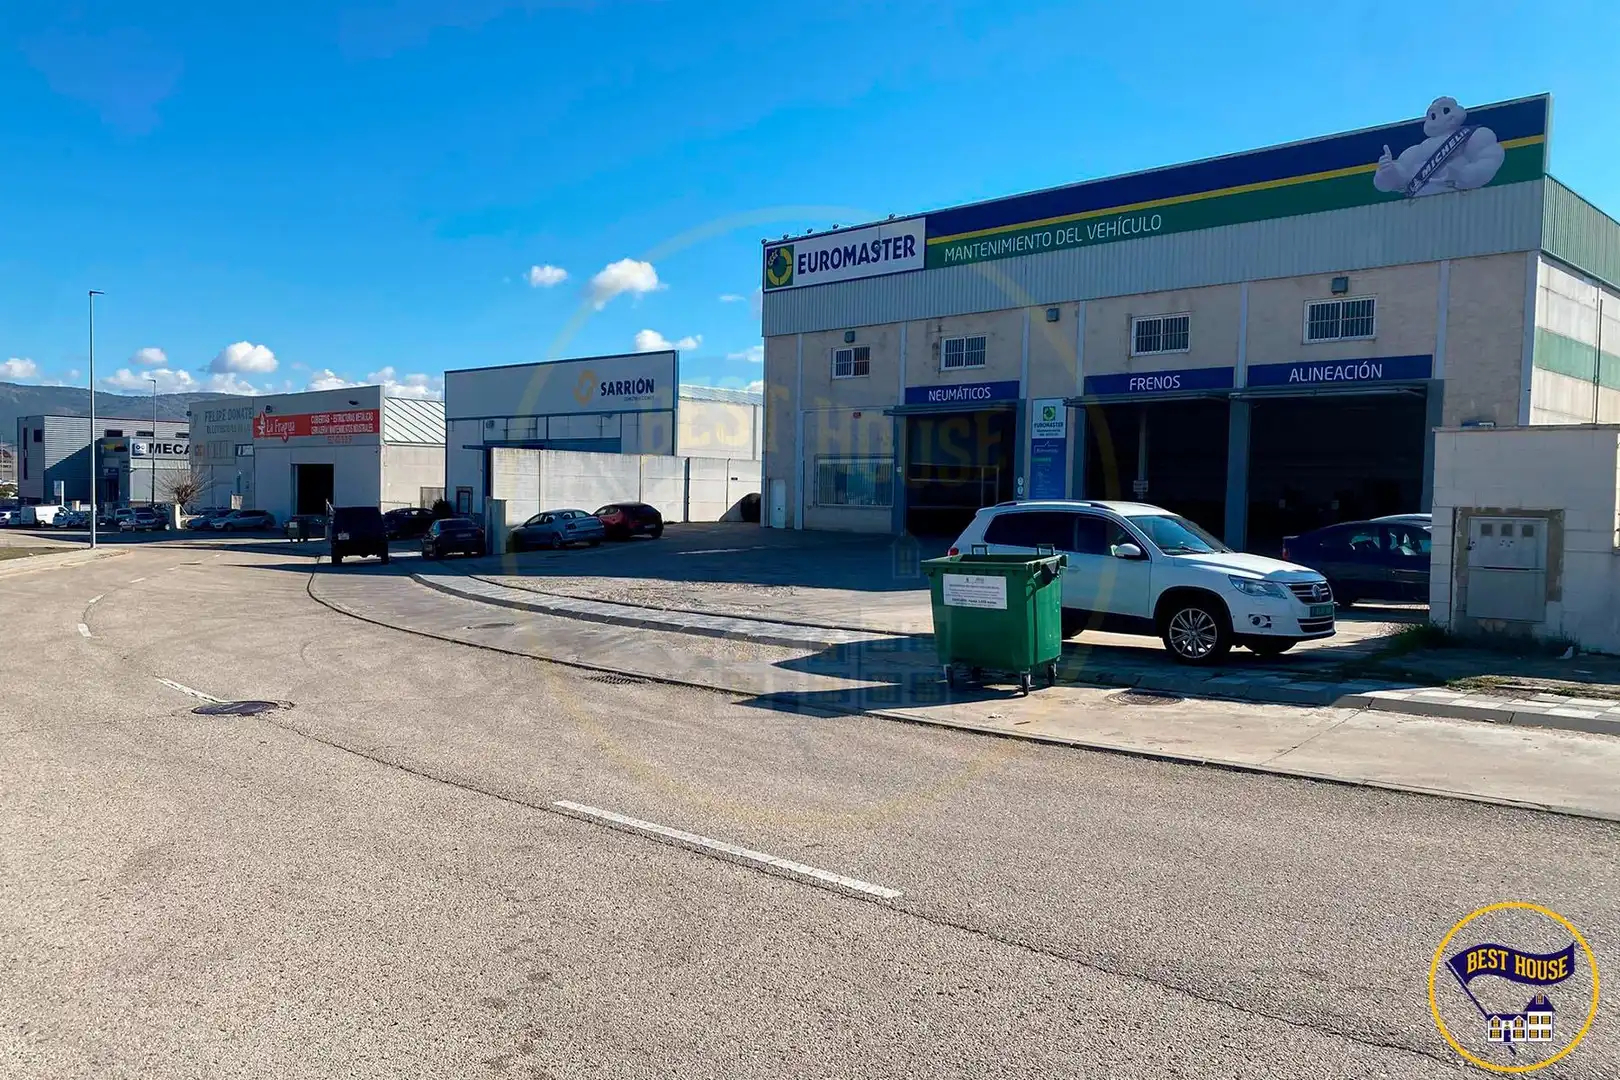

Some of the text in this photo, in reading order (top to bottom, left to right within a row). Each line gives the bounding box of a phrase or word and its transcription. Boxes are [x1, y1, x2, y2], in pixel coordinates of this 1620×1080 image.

[1421, 127, 1470, 178] MICHELIN
[944, 214, 1162, 263] MANTENIMIENTO DEL VEHÍCULO
[797, 234, 916, 275] EUROMASTER
[1289, 360, 1382, 382] ALINEACIÓN
[601, 378, 655, 396] SARRIÓN
[1129, 374, 1181, 391] FRENOS
[928, 386, 992, 402] NEUMÁTICOS
[266, 419, 273, 433] La
[274, 418, 295, 438] Fragua
